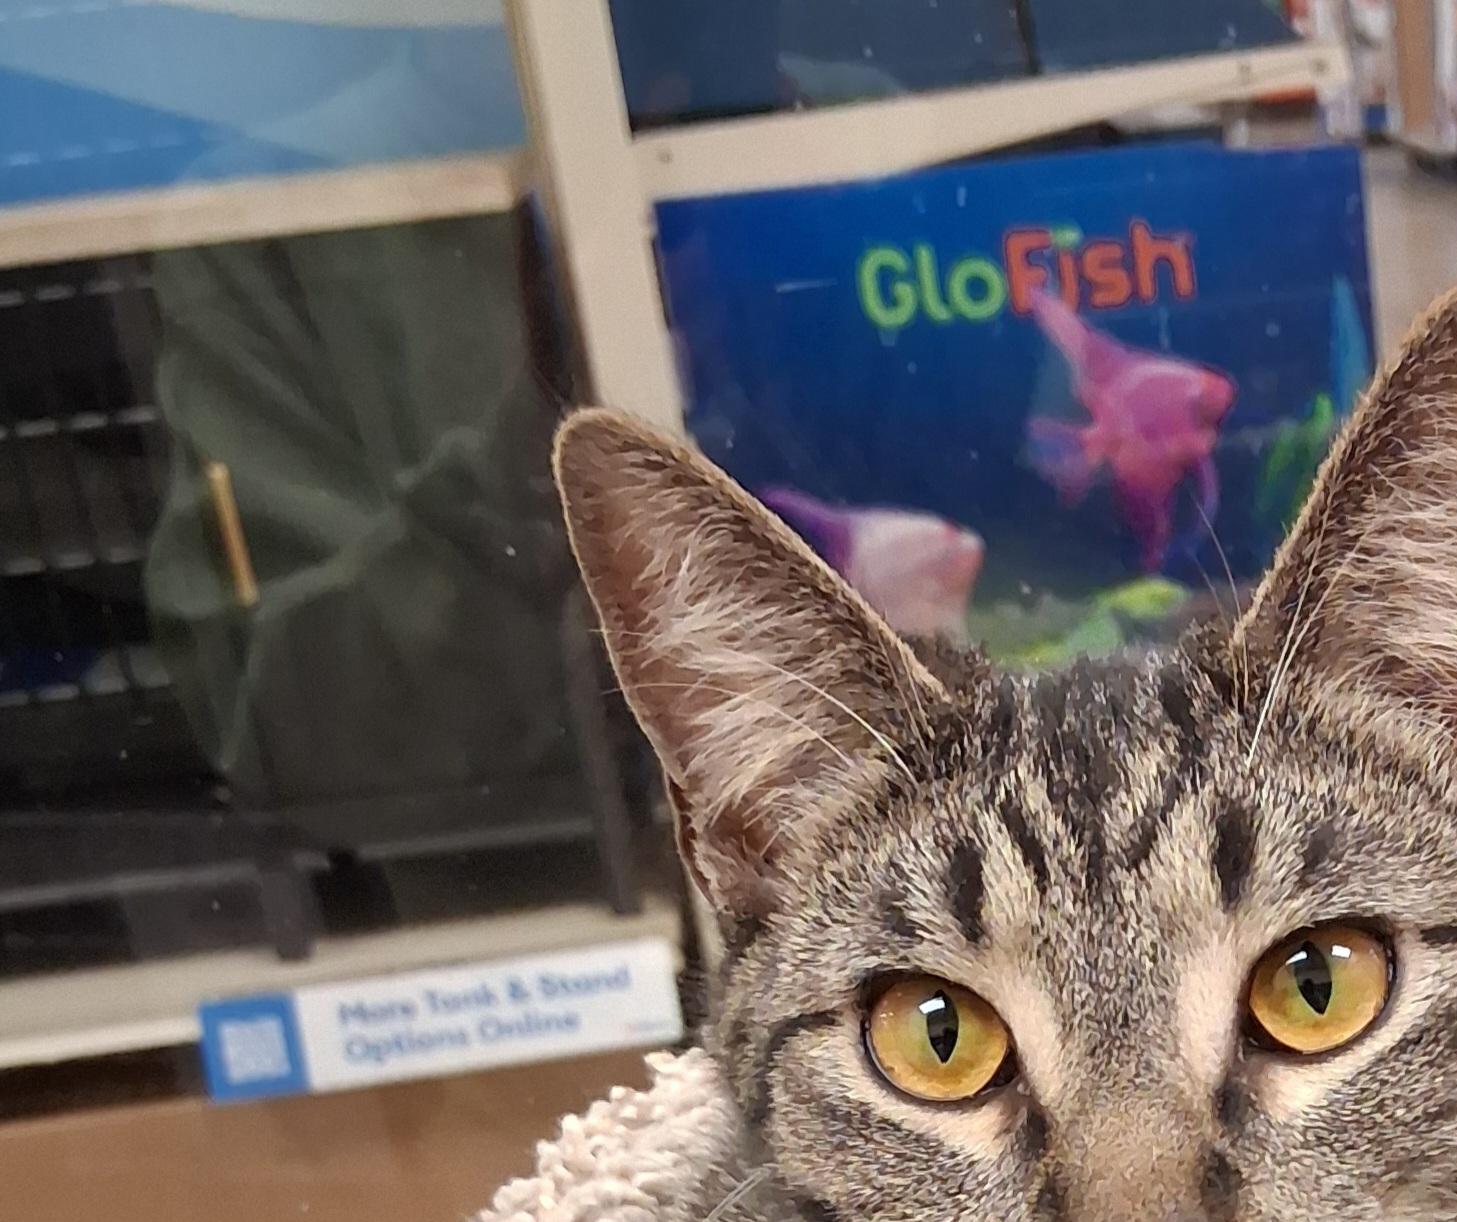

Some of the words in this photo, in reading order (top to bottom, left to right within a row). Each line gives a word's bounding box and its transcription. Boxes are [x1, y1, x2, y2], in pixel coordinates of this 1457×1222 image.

[858, 218, 1196, 327] GloFish
[339, 1000, 418, 1024] More
[424, 983, 500, 1014] Tank
[507, 976, 530, 1000] &
[538, 966, 631, 996] Stand
[345, 1026, 469, 1063] Options
[479, 1010, 580, 1041] Online
